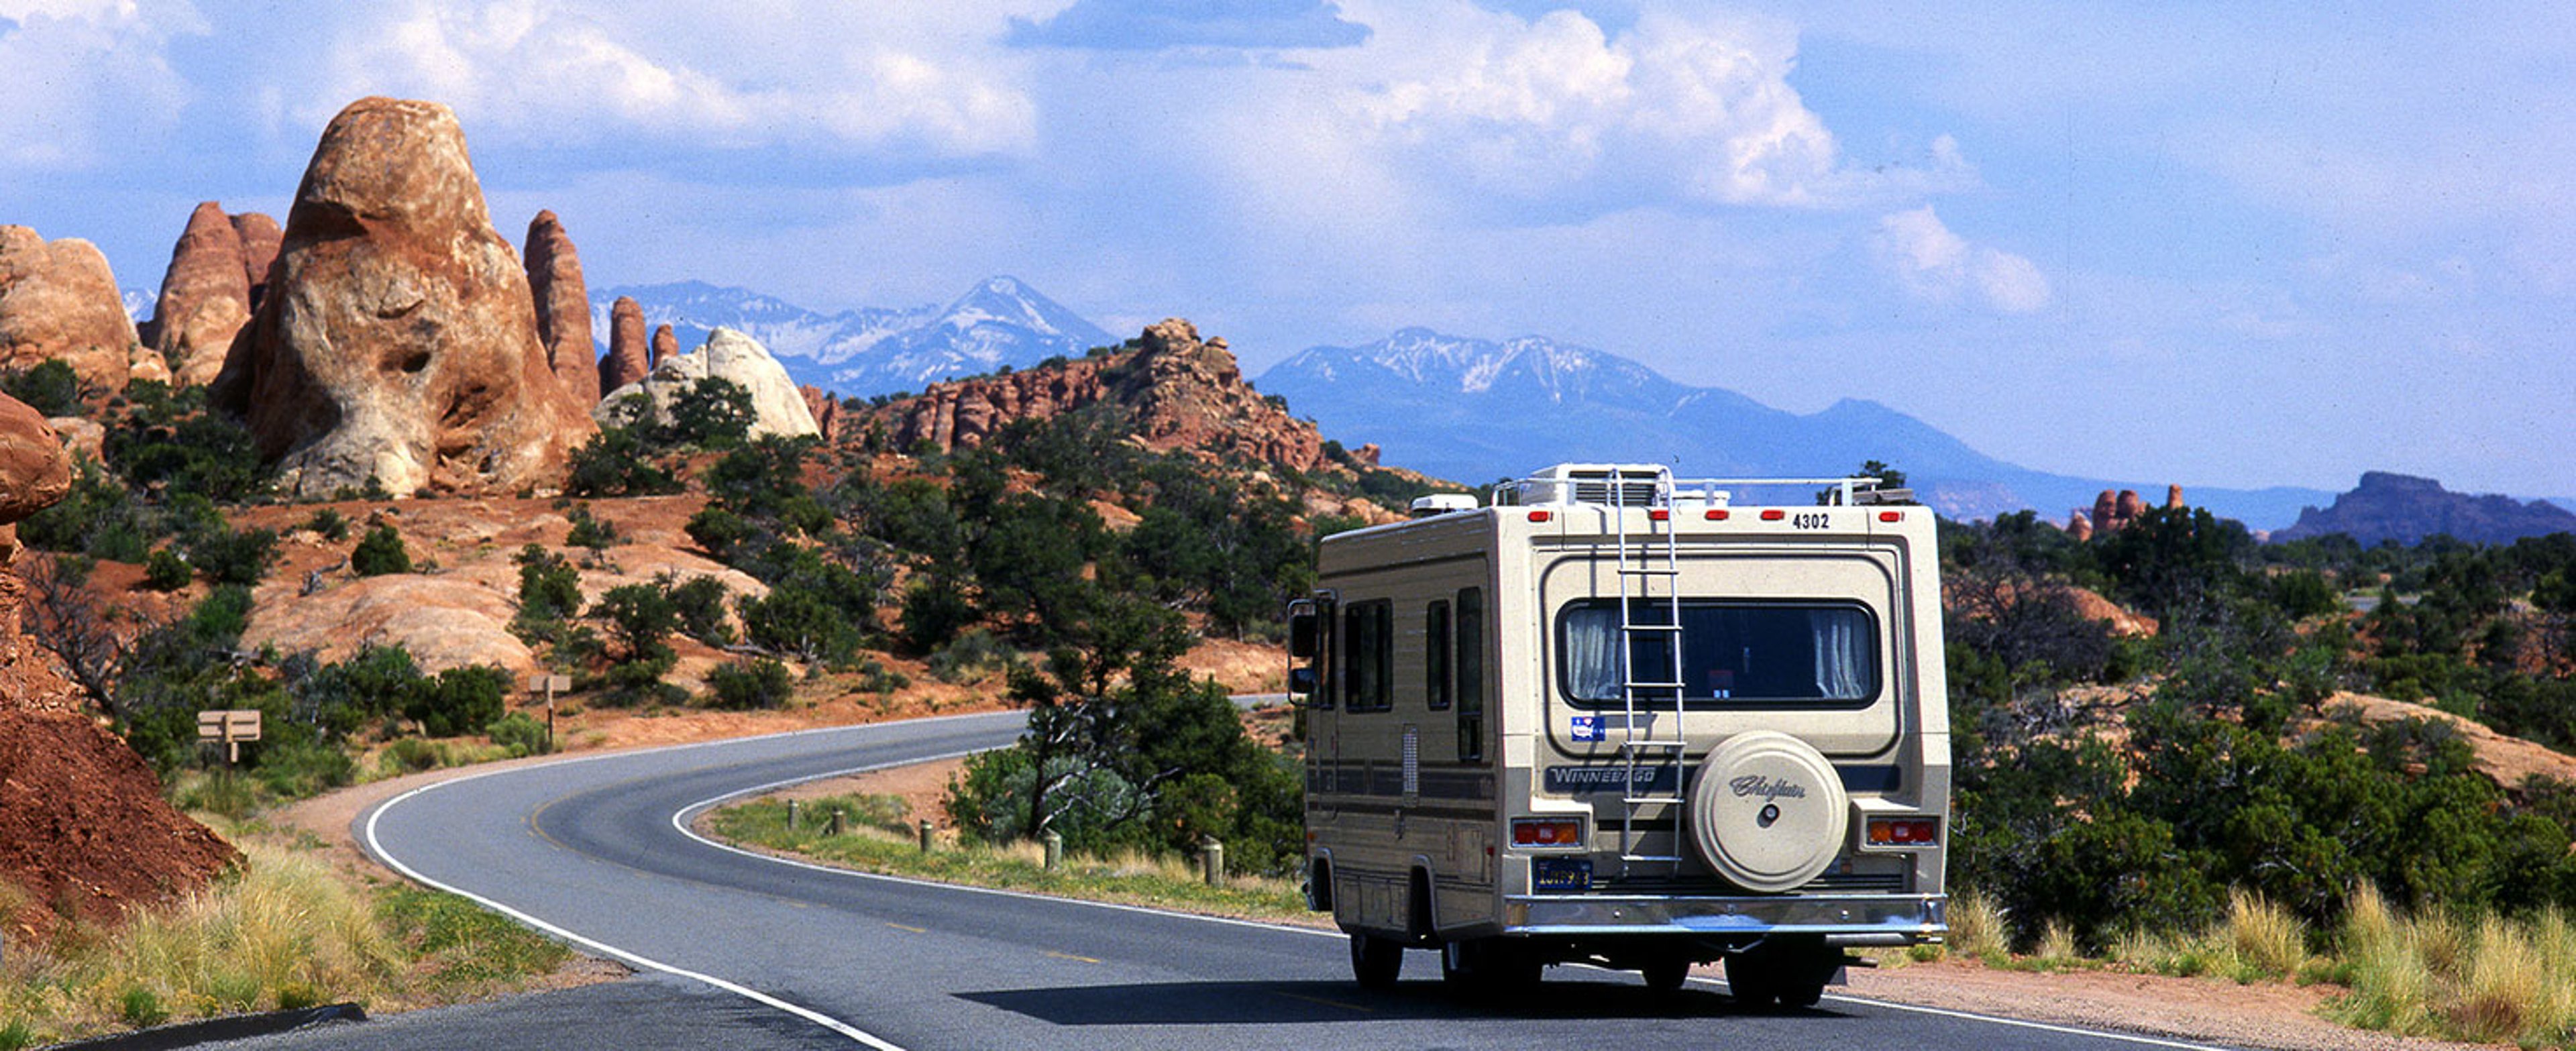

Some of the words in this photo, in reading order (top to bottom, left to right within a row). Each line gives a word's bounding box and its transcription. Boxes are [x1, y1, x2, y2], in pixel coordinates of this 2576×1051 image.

[1792, 513, 1830, 529] 4302
[1550, 768, 1656, 783] WINNEBAGO
[1729, 775, 1806, 802] Chieftain
